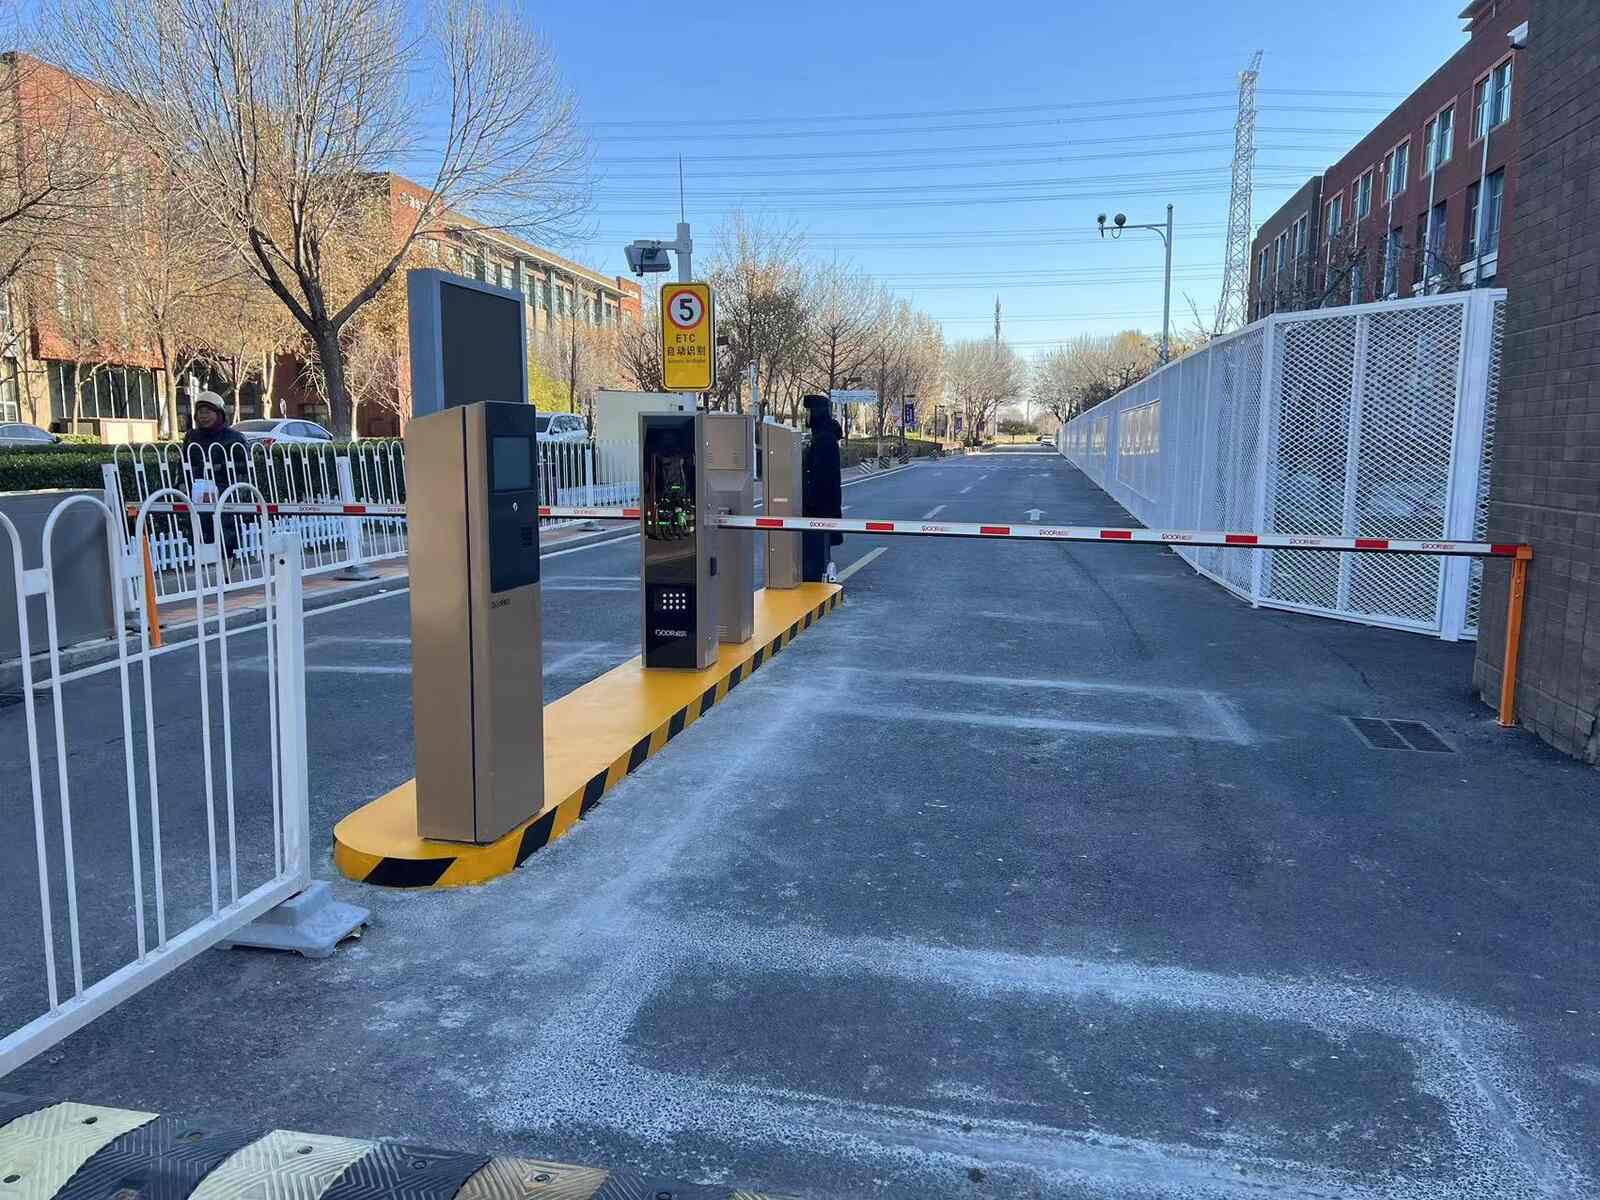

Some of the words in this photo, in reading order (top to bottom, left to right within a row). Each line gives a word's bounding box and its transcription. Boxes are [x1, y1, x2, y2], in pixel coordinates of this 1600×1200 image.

[679, 298, 694, 321] 5
[676, 334, 696, 343] ETC
[667, 344, 706, 356] 自动识别
